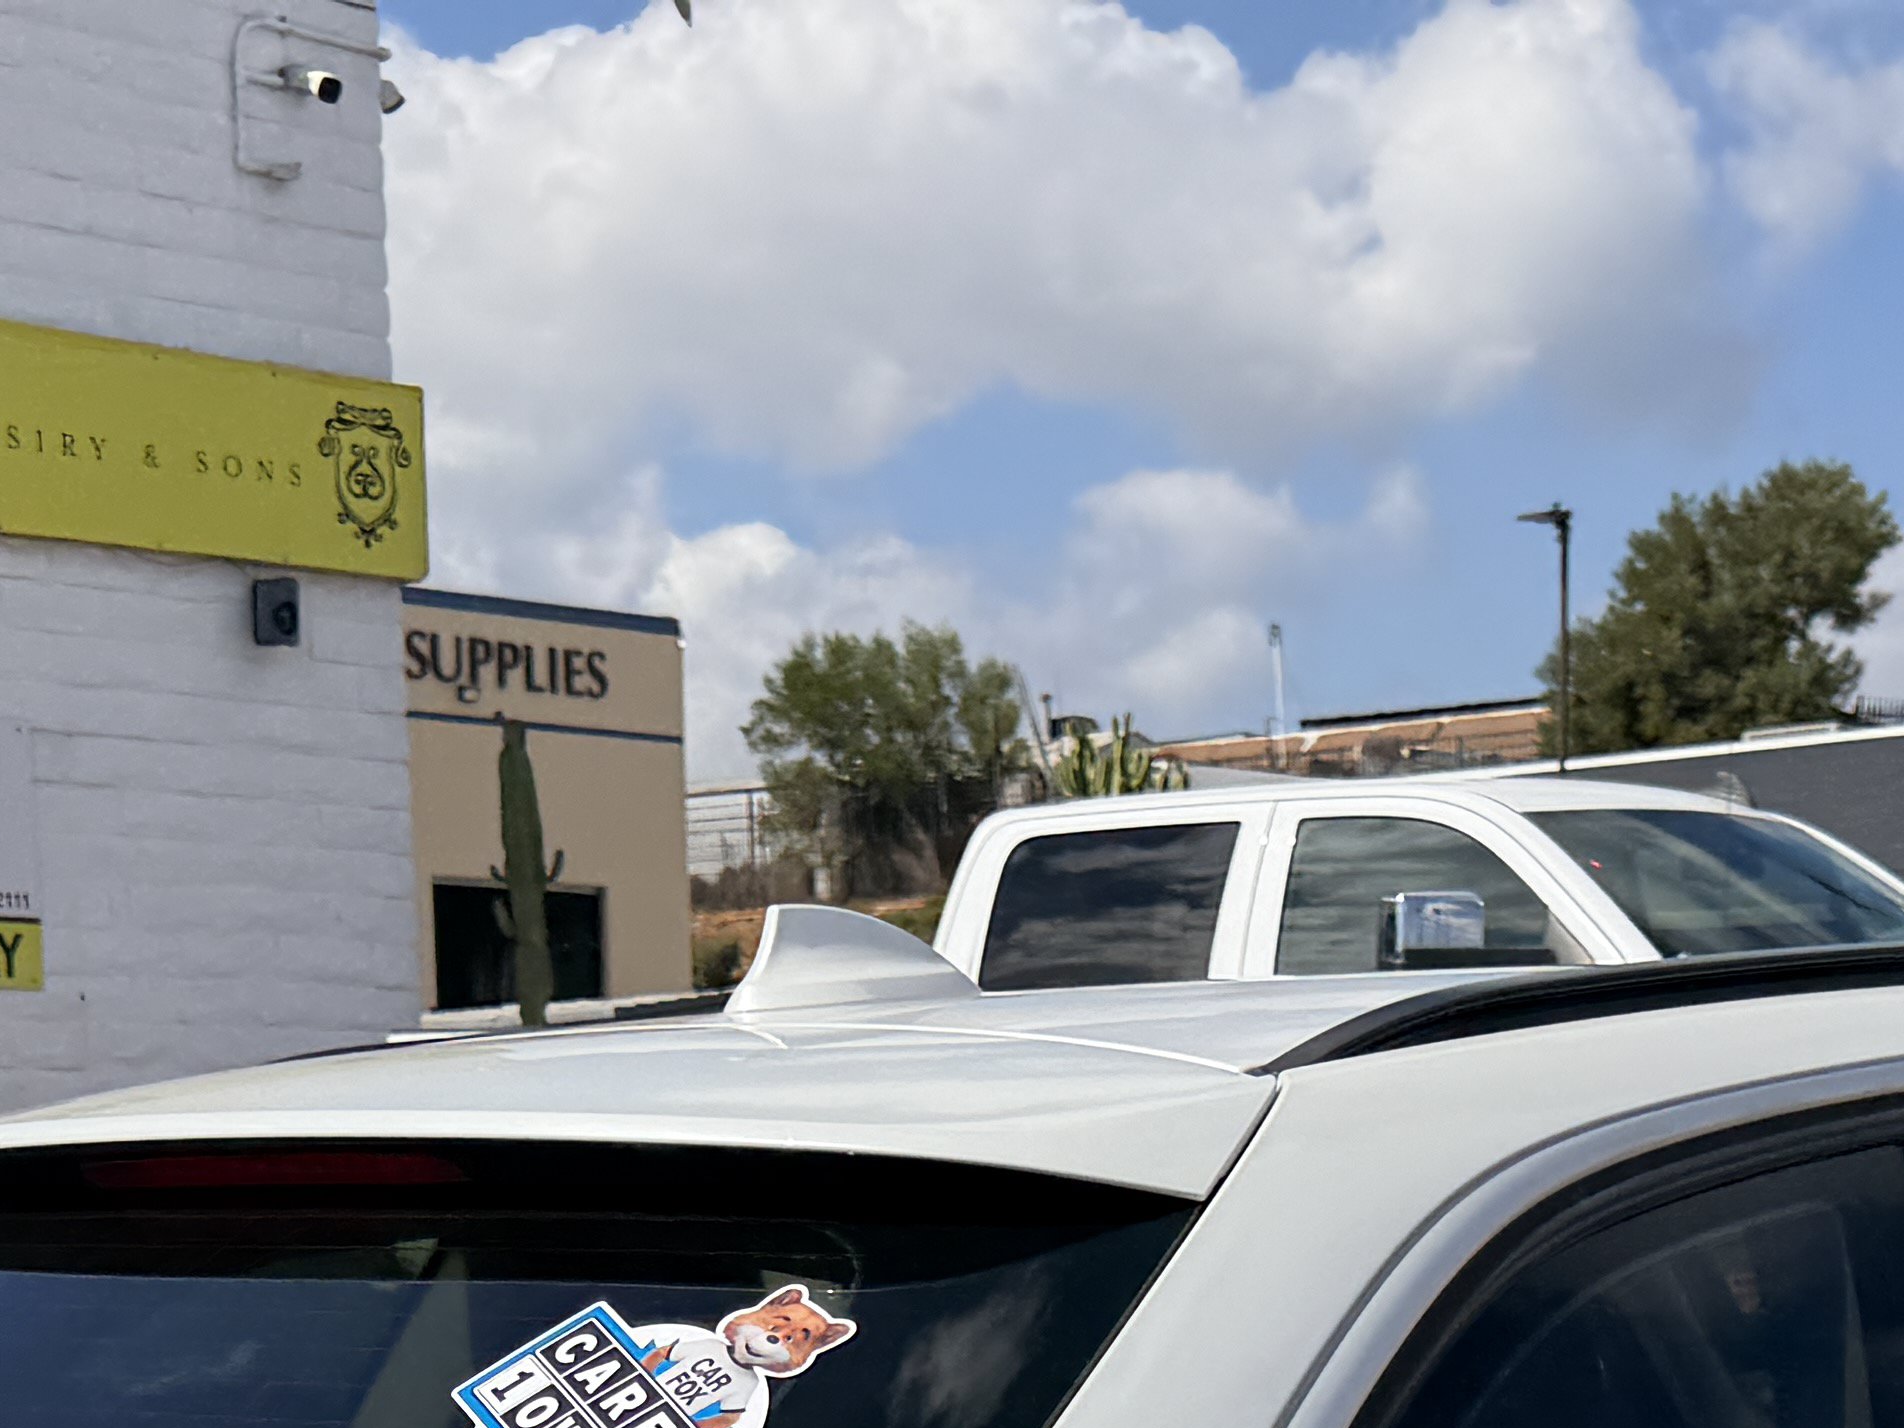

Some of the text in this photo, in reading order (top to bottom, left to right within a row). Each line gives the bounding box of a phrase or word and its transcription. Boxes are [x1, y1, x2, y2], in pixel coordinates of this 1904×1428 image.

[6, 425, 302, 487] SIRY & SONS
[405, 630, 609, 700] SUPPLIES
[665, 1372, 708, 1406] FOX
[690, 1357, 732, 1393] CAR
